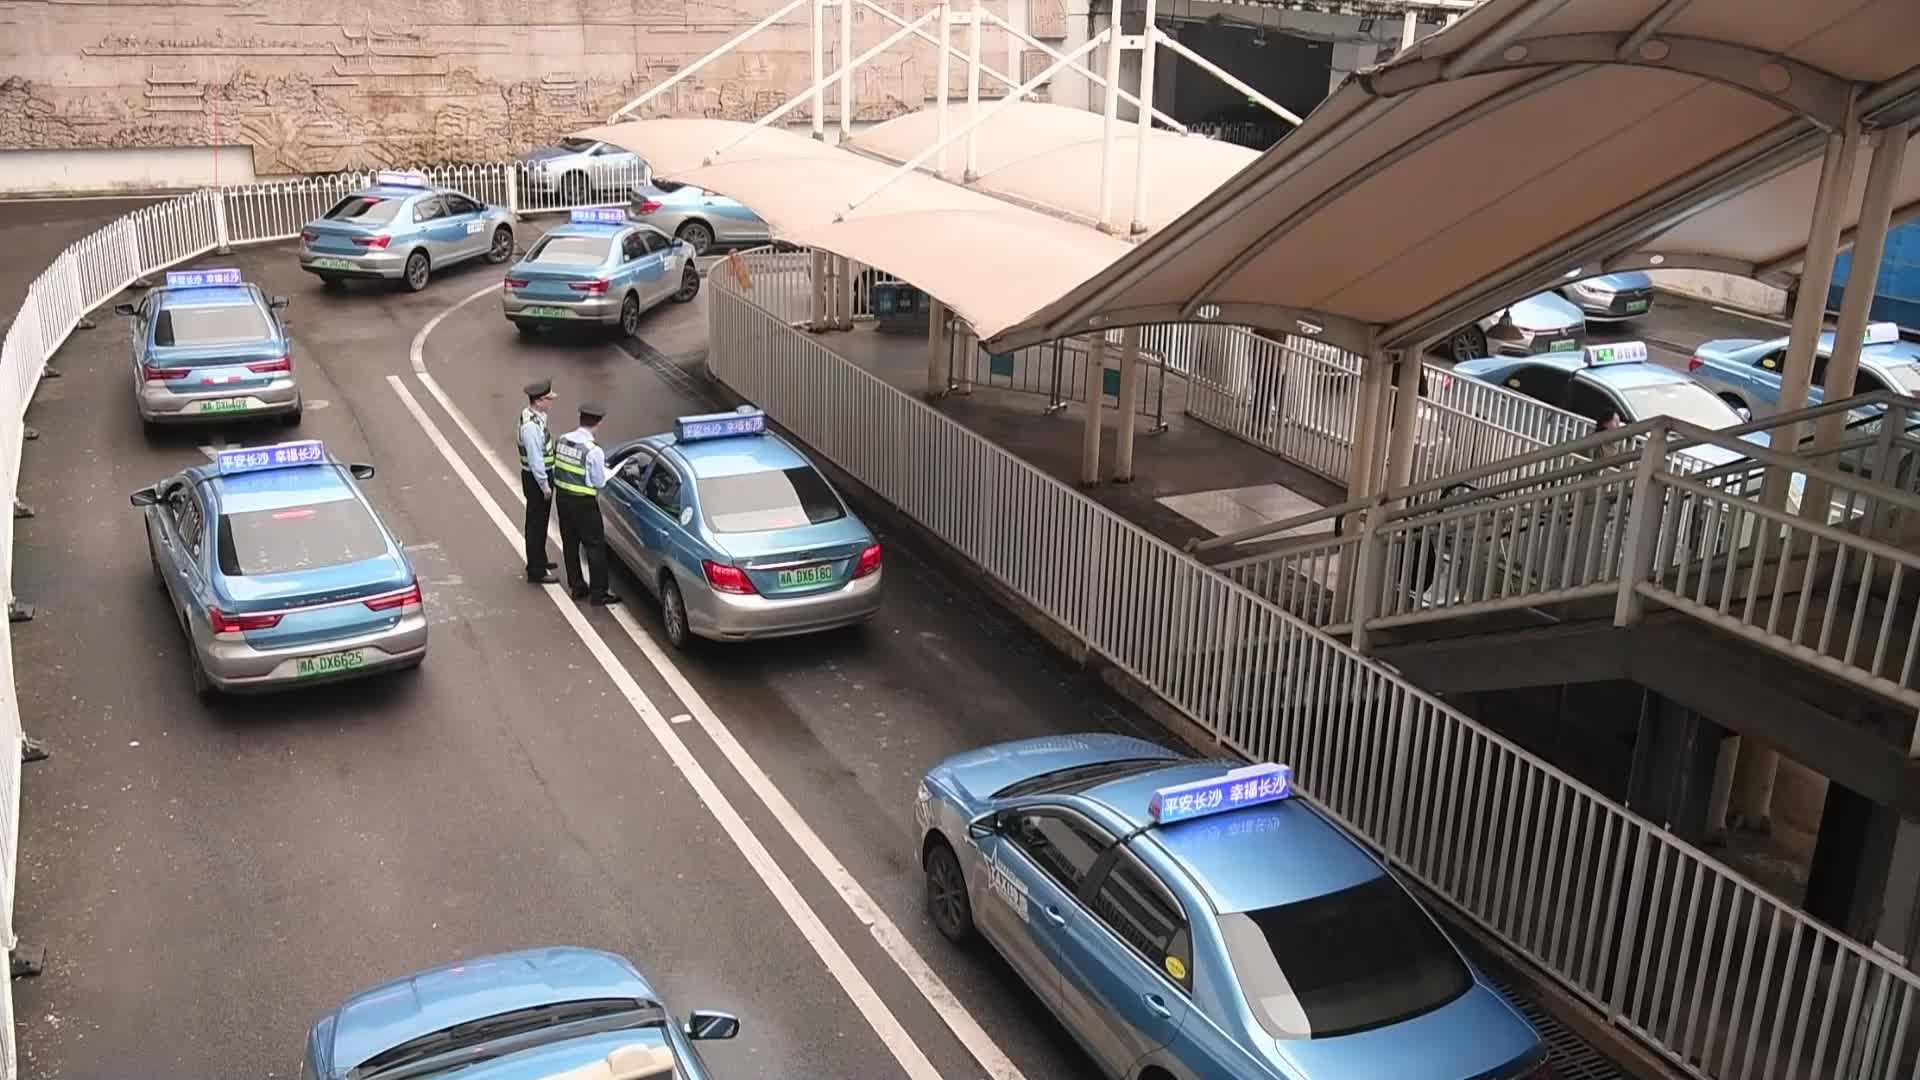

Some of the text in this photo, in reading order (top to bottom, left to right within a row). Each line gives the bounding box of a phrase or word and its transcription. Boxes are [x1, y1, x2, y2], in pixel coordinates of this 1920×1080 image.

[223, 446, 321, 468] 平安长沙 幸福长沙
[1165, 774, 1287, 816] 平安长沙 幸福长沙
